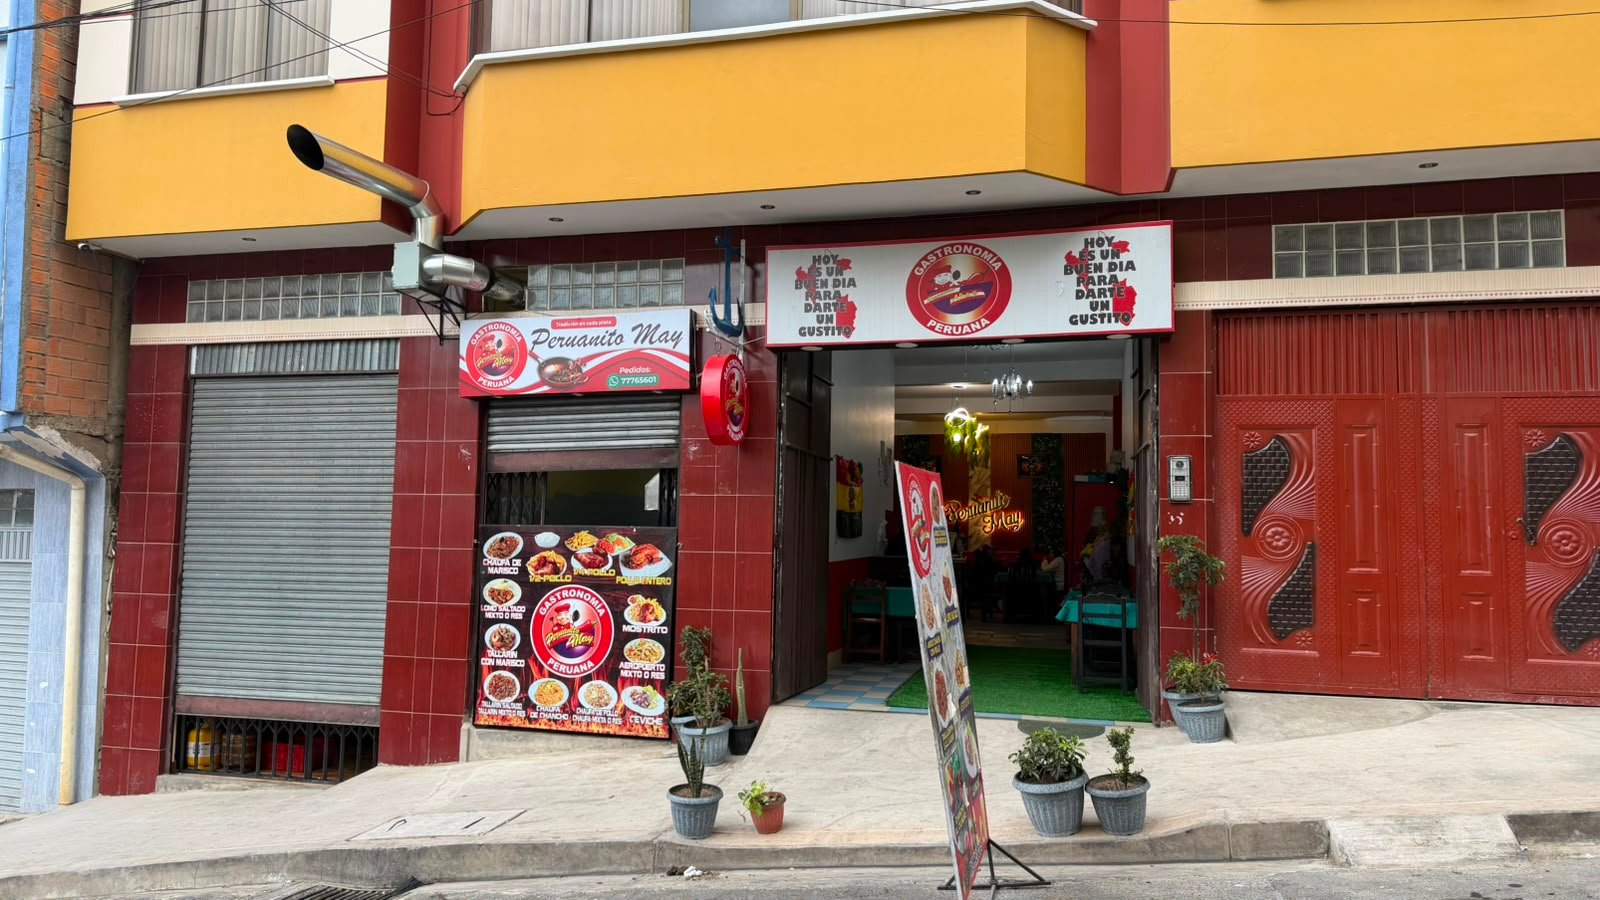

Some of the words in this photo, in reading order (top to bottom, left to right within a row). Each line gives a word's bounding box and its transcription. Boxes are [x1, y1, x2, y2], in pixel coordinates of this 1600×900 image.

[1084, 236, 1115, 248] HOY
[812, 254, 839, 265] HOY
[1079, 250, 1095, 261] ES
[1100, 249, 1120, 260] UN
[808, 267, 822, 277] ES
[826, 266, 843, 276] UN
[1064, 262, 1103, 275] BUEN
[1107, 260, 1136, 272] DIA
[795, 278, 828, 290] BUEN
[832, 278, 857, 288] DIA
[1076, 274, 1119, 287] PARA
[805, 290, 841, 301] PARA
[1075, 287, 1125, 300] DARTE
[804, 302, 847, 313] DARTE
[1089, 300, 1110, 311] UN
[816, 314, 833, 324] UN
[1069, 312, 1131, 325] GUSTITO
[798, 326, 852, 337] GUSTITO
[927, 318, 990, 334] PERUANA
[531, 328, 624, 352] Peruanito
[631, 323, 683, 349] May
[477, 375, 515, 388] PERUANA
[620, 376, 657, 384] 77765601
[982, 511, 1024, 535] May
[481, 658, 494, 666] CON
[547, 657, 595, 674] PERUANA
[630, 716, 662, 725] CEVICHE
